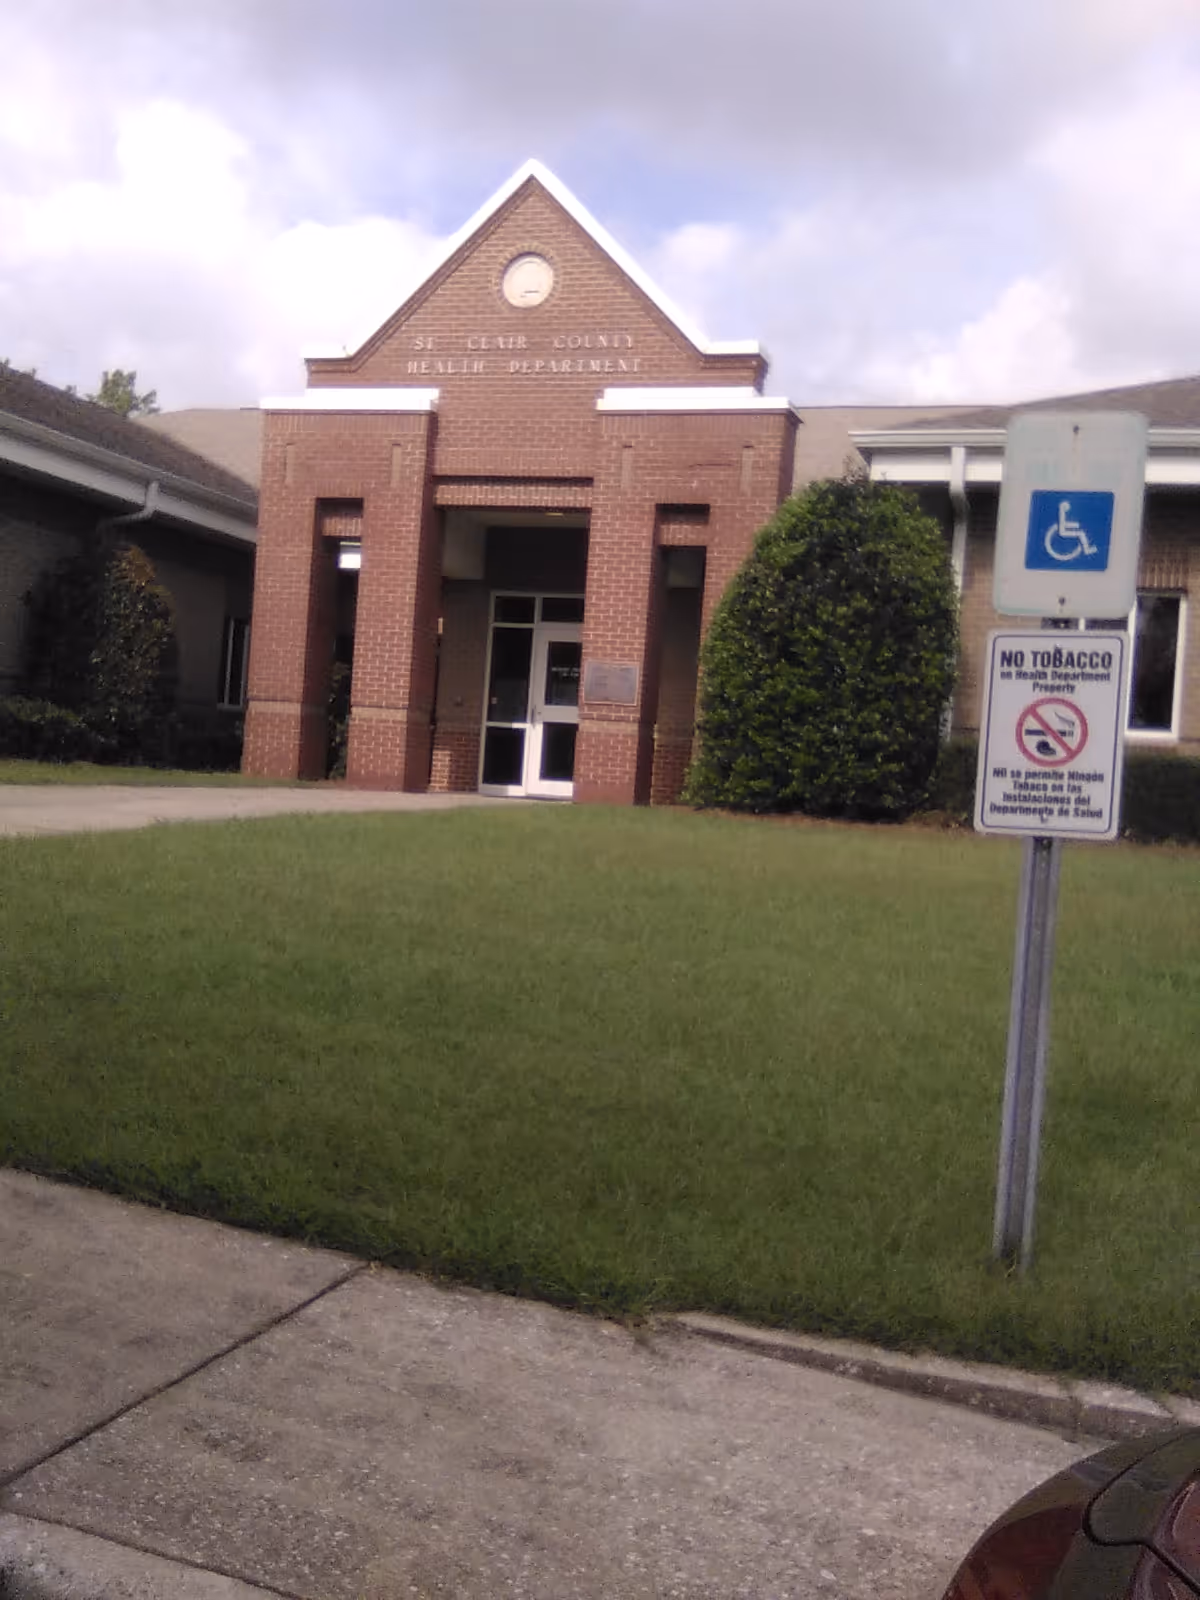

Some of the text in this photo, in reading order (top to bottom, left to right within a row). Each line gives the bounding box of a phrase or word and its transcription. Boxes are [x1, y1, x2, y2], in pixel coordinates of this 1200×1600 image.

[406, 358, 642, 375] HEALTH DEPARTMENT
[1000, 650, 1113, 669] NO TOBACCO
[1015, 669, 1048, 680] Health
[1051, 671, 1111, 681] Department
[1032, 682, 1076, 694] Property
